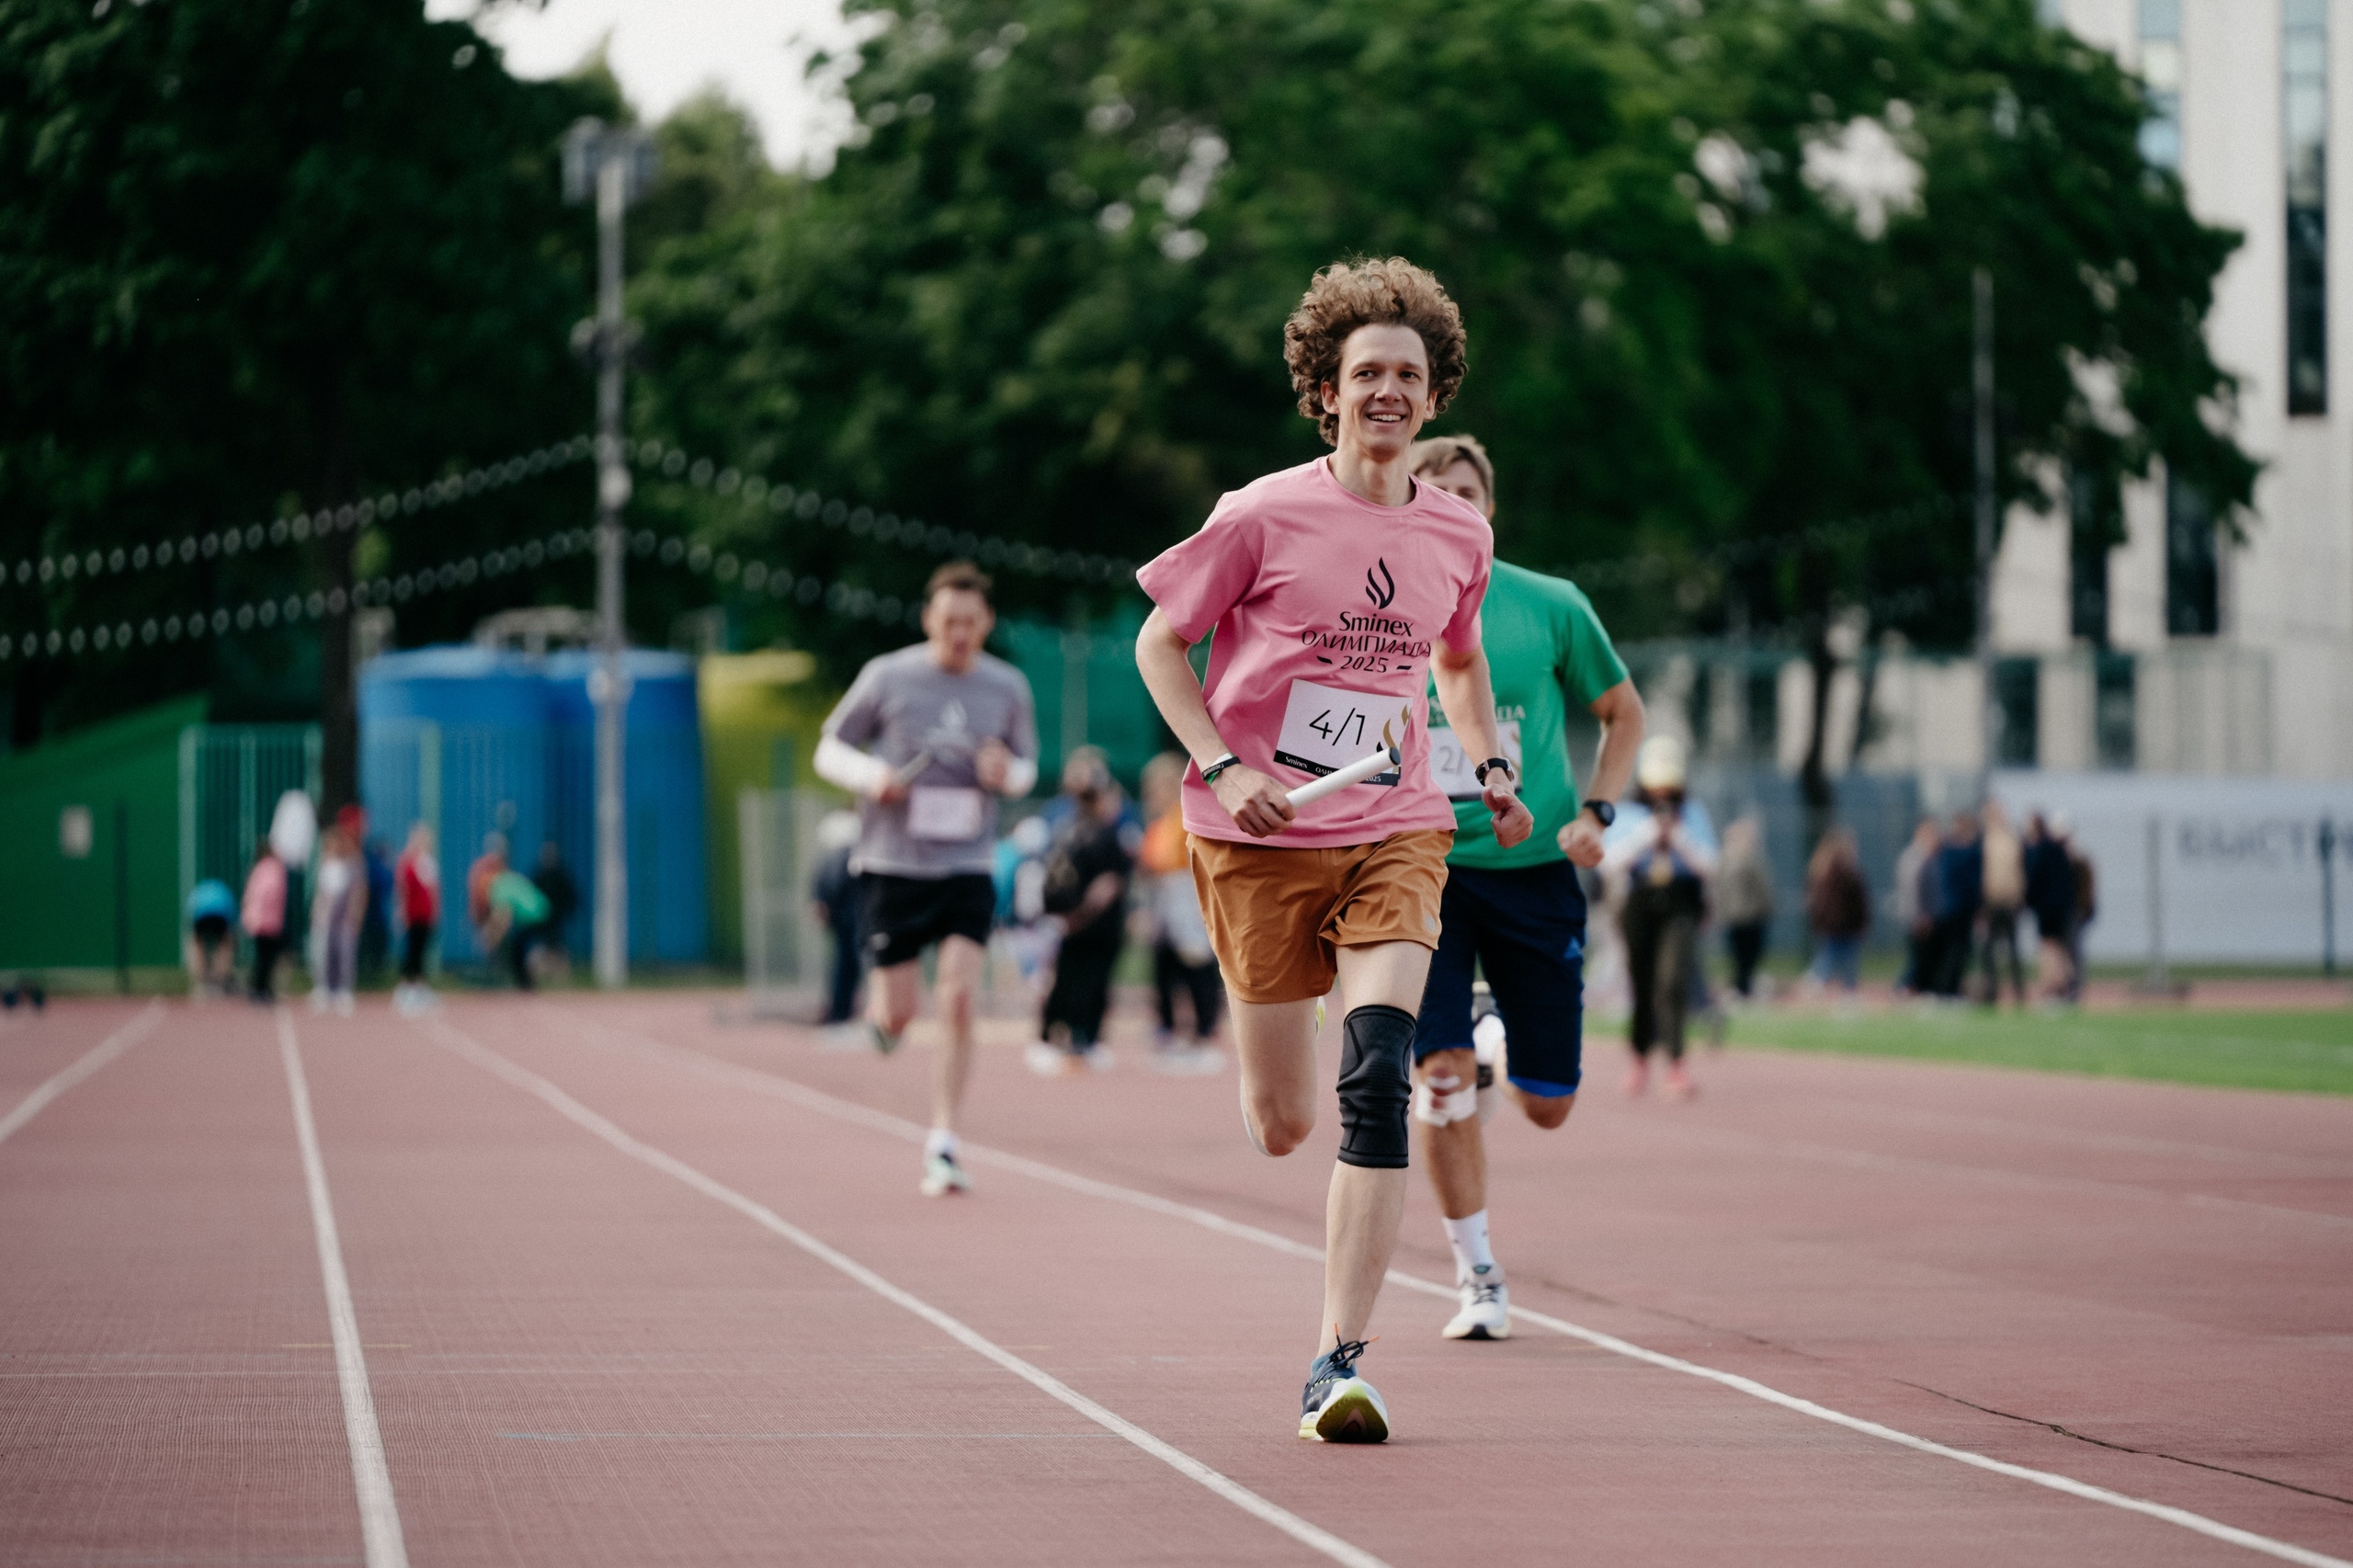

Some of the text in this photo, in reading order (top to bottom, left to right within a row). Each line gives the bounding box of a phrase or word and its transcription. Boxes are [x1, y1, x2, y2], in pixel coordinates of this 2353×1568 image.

[1338, 611, 1414, 637] Sminex
[1302, 630, 1431, 657] ОЛИМПИАДА
[1340, 655, 1389, 673] 2025
[1309, 707, 1366, 746] 4/1
[1285, 756, 1308, 768] Sminex
